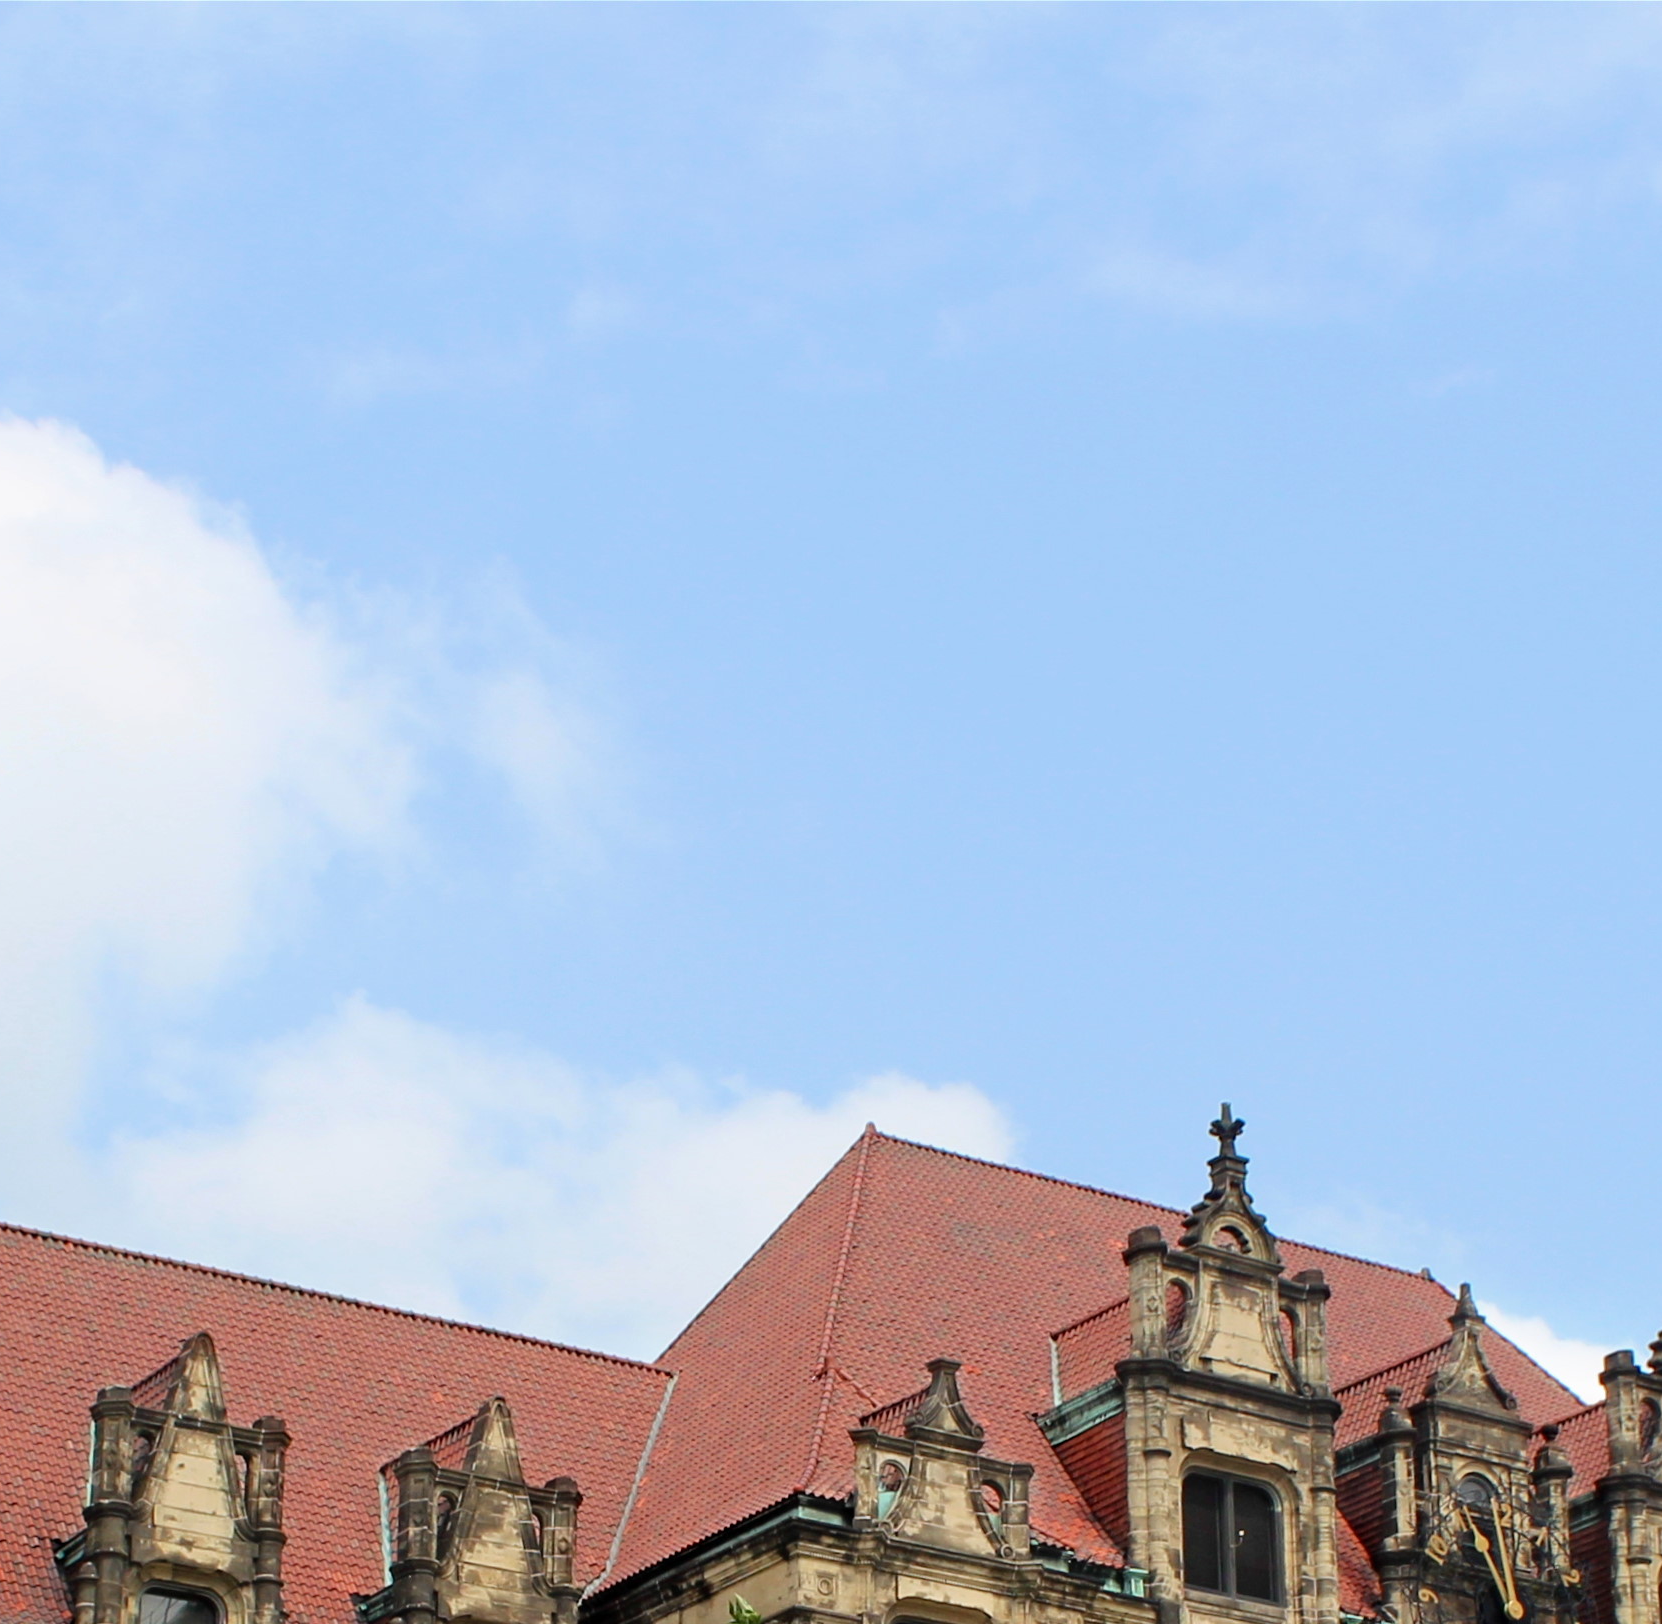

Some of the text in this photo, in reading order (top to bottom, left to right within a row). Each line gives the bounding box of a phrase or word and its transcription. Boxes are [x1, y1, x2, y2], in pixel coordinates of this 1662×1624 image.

[1424, 1533, 1449, 1566] 10
[1561, 1568, 1581, 1588] 2
[1418, 1588, 1438, 1604] 9
